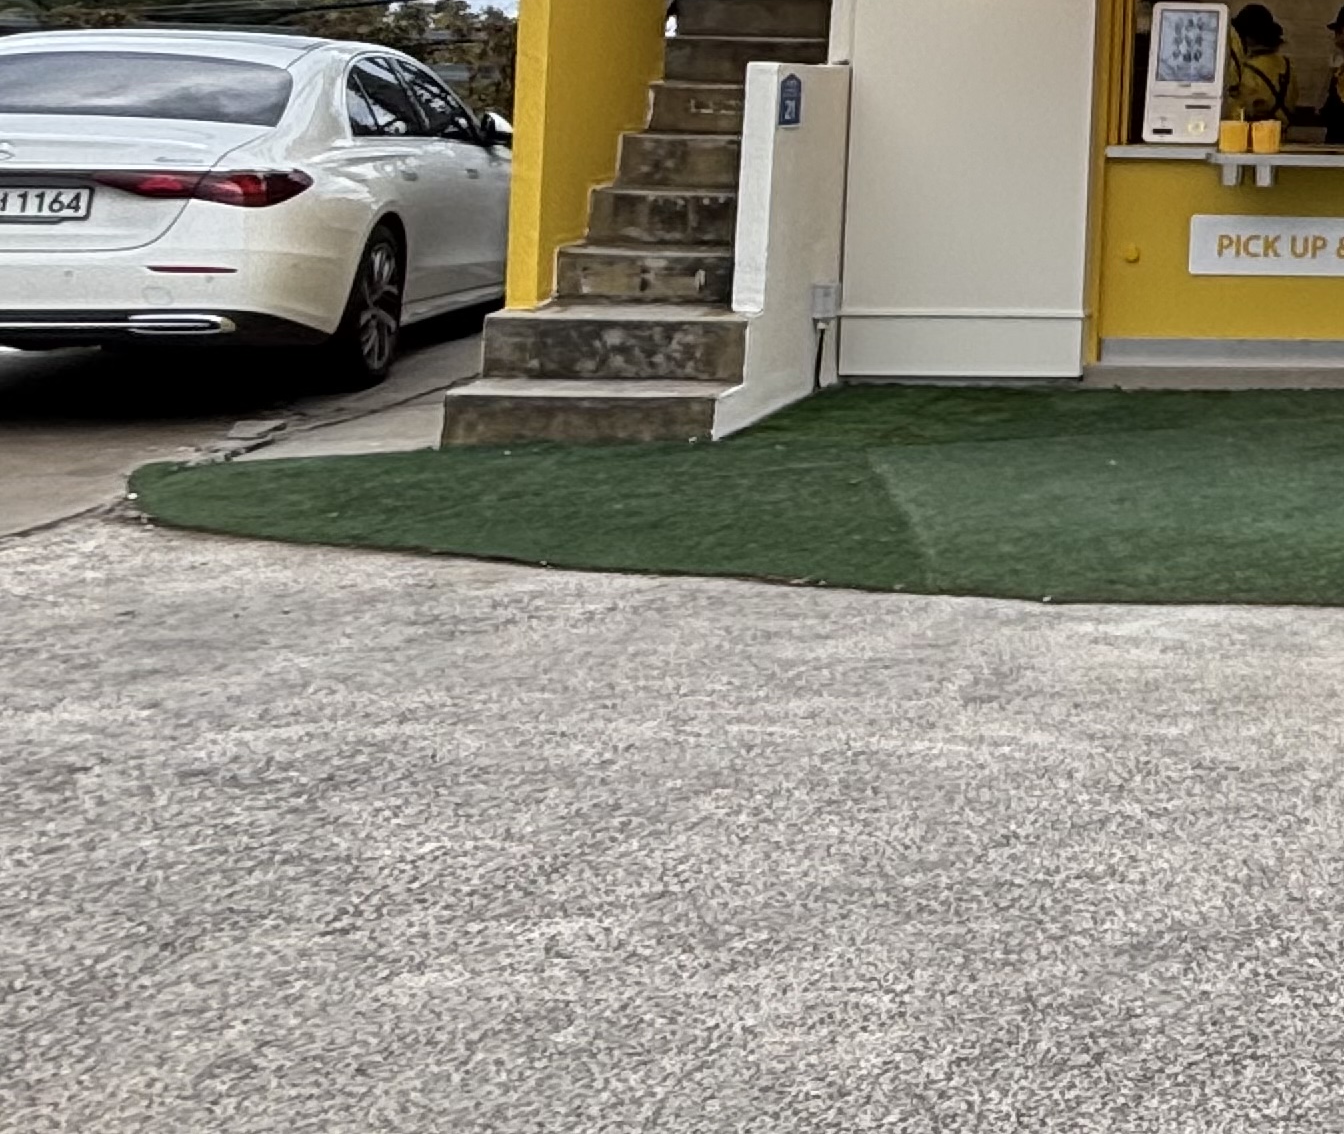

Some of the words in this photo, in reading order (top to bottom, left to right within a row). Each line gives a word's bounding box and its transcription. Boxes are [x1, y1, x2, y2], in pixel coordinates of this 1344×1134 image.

[17, 190, 81, 213] 1164
[1216, 233, 1282, 258] PICK
[1290, 234, 1328, 259] UP
